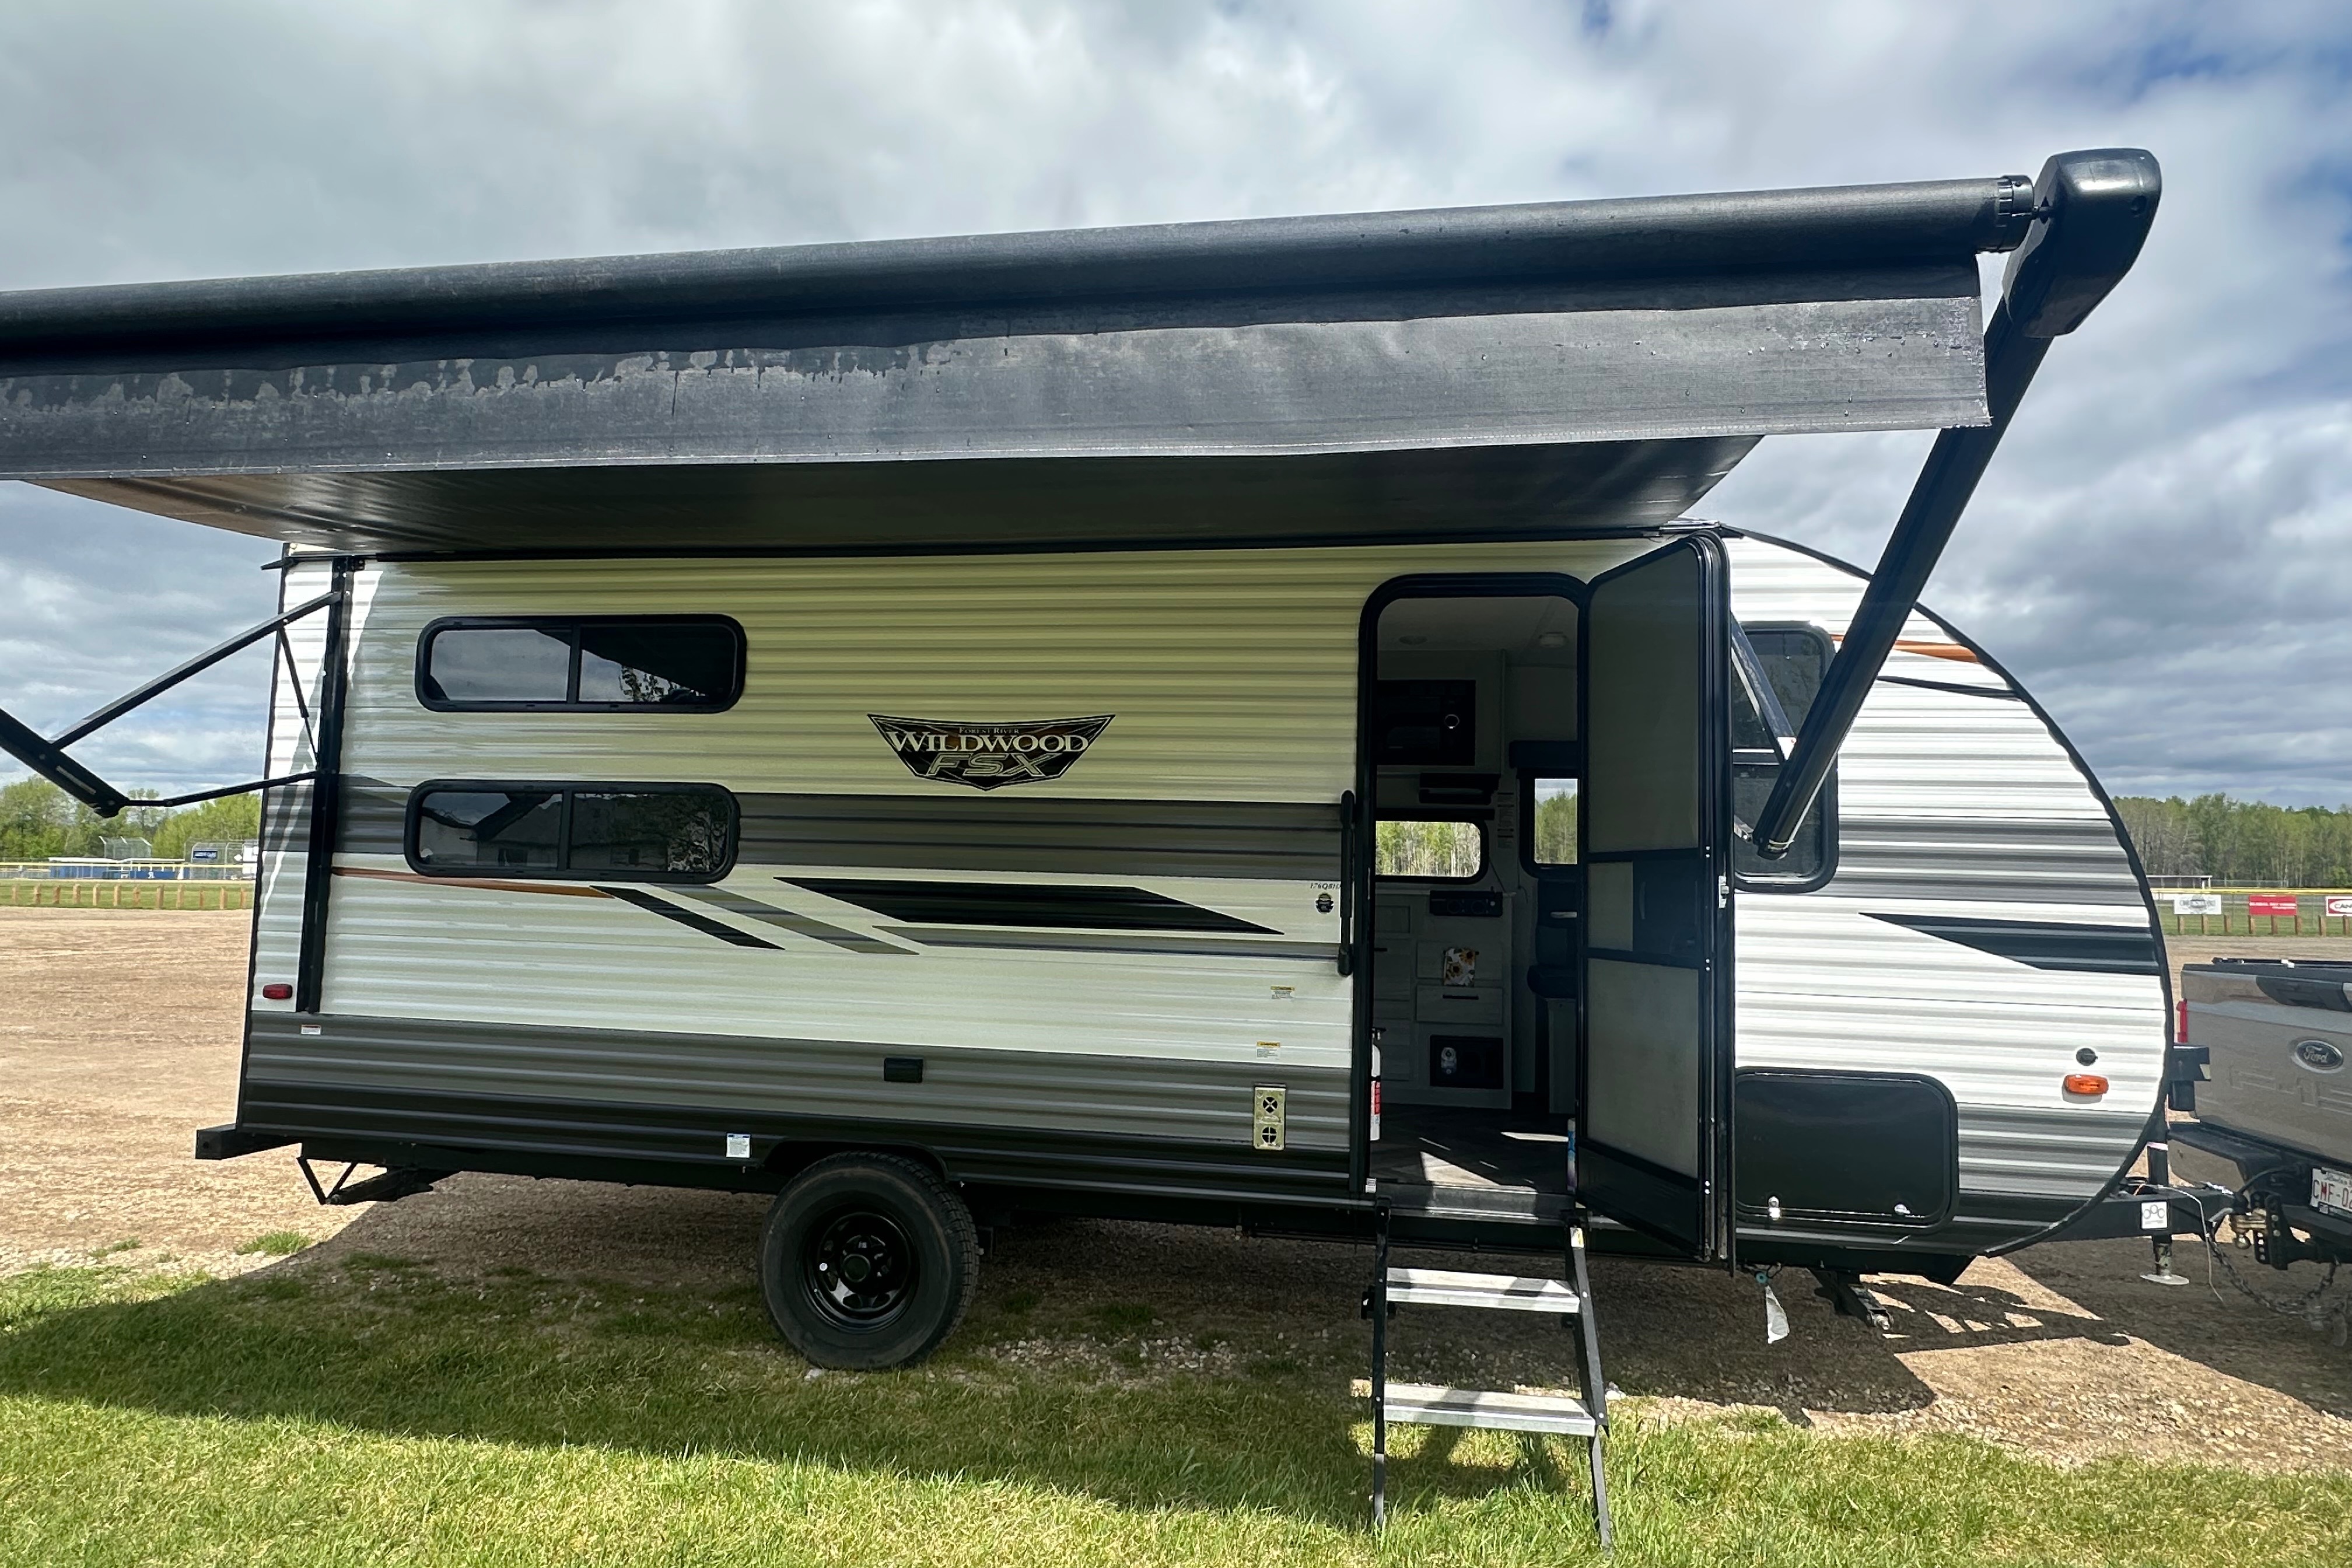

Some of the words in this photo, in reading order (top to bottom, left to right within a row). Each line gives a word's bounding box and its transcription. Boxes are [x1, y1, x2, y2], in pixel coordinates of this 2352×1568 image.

[886, 732, 1089, 752] WILDWOOD
[926, 752, 1063, 777] FSX
[2303, 1045, 2330, 1063] Ford
